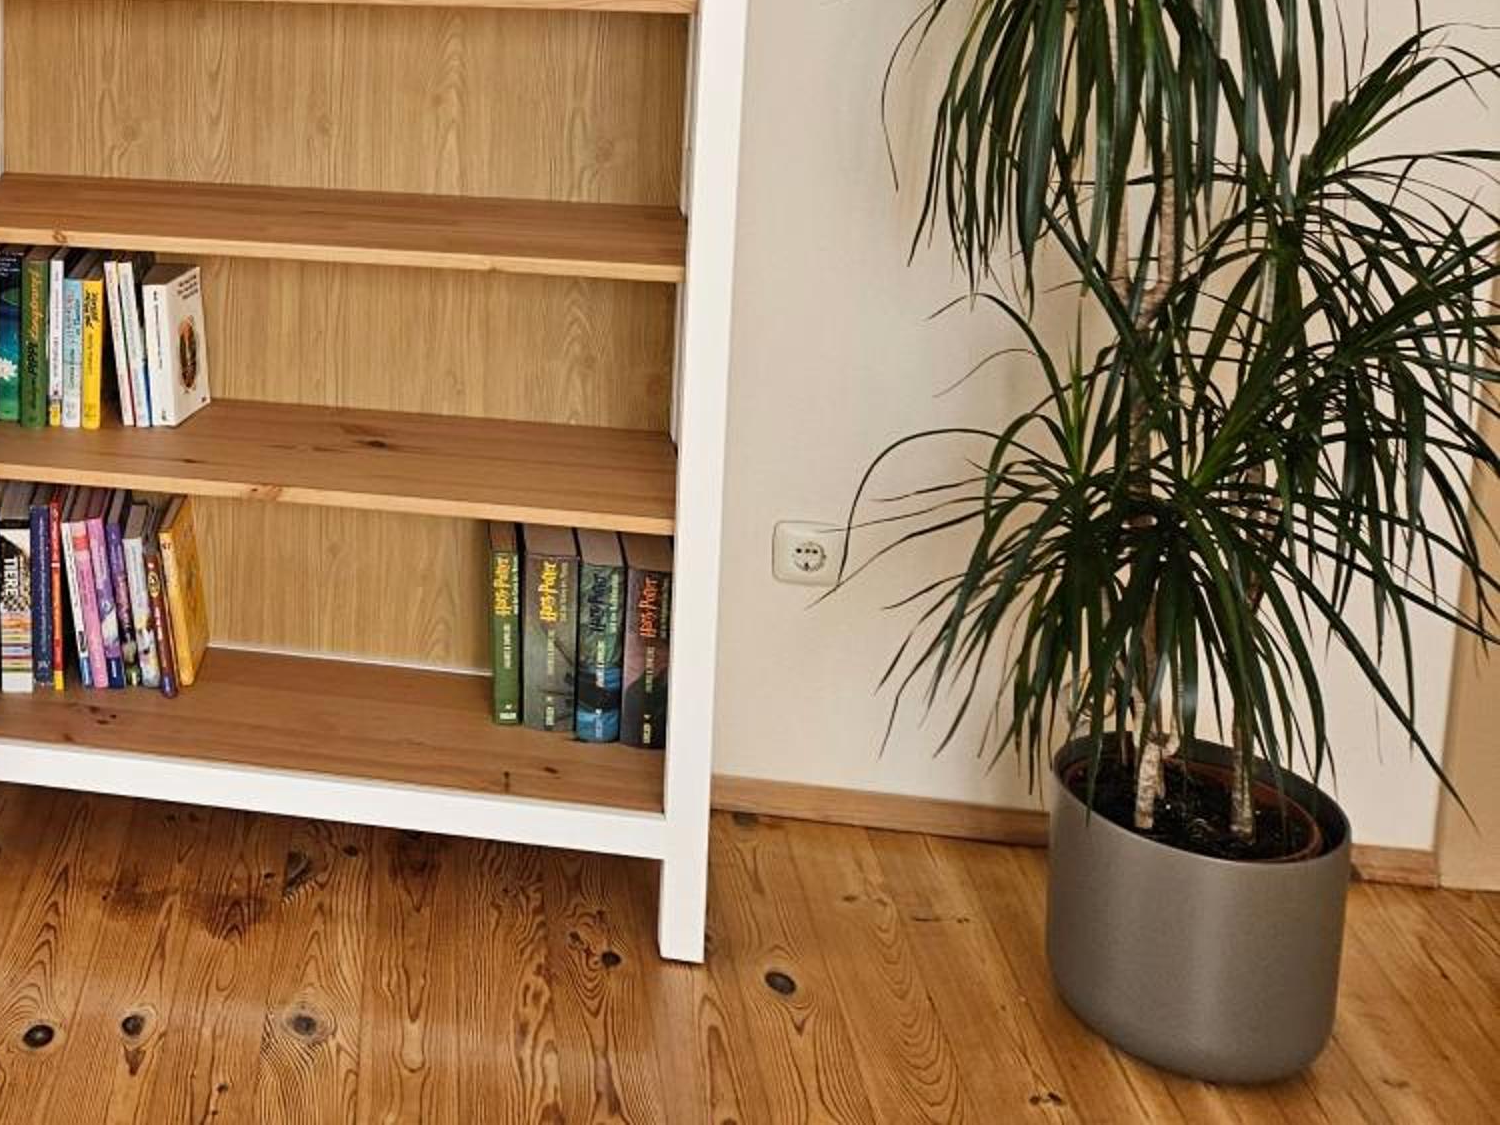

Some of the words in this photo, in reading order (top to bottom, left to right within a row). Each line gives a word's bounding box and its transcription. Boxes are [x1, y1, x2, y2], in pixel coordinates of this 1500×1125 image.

[25, 341, 38, 376] PIPPI
[4, 556, 19, 597] TIERE
[538, 562, 558, 594] Potter
[539, 594, 557, 621] Harry
[638, 577, 659, 612] Potter
[639, 612, 657, 638] Harry
